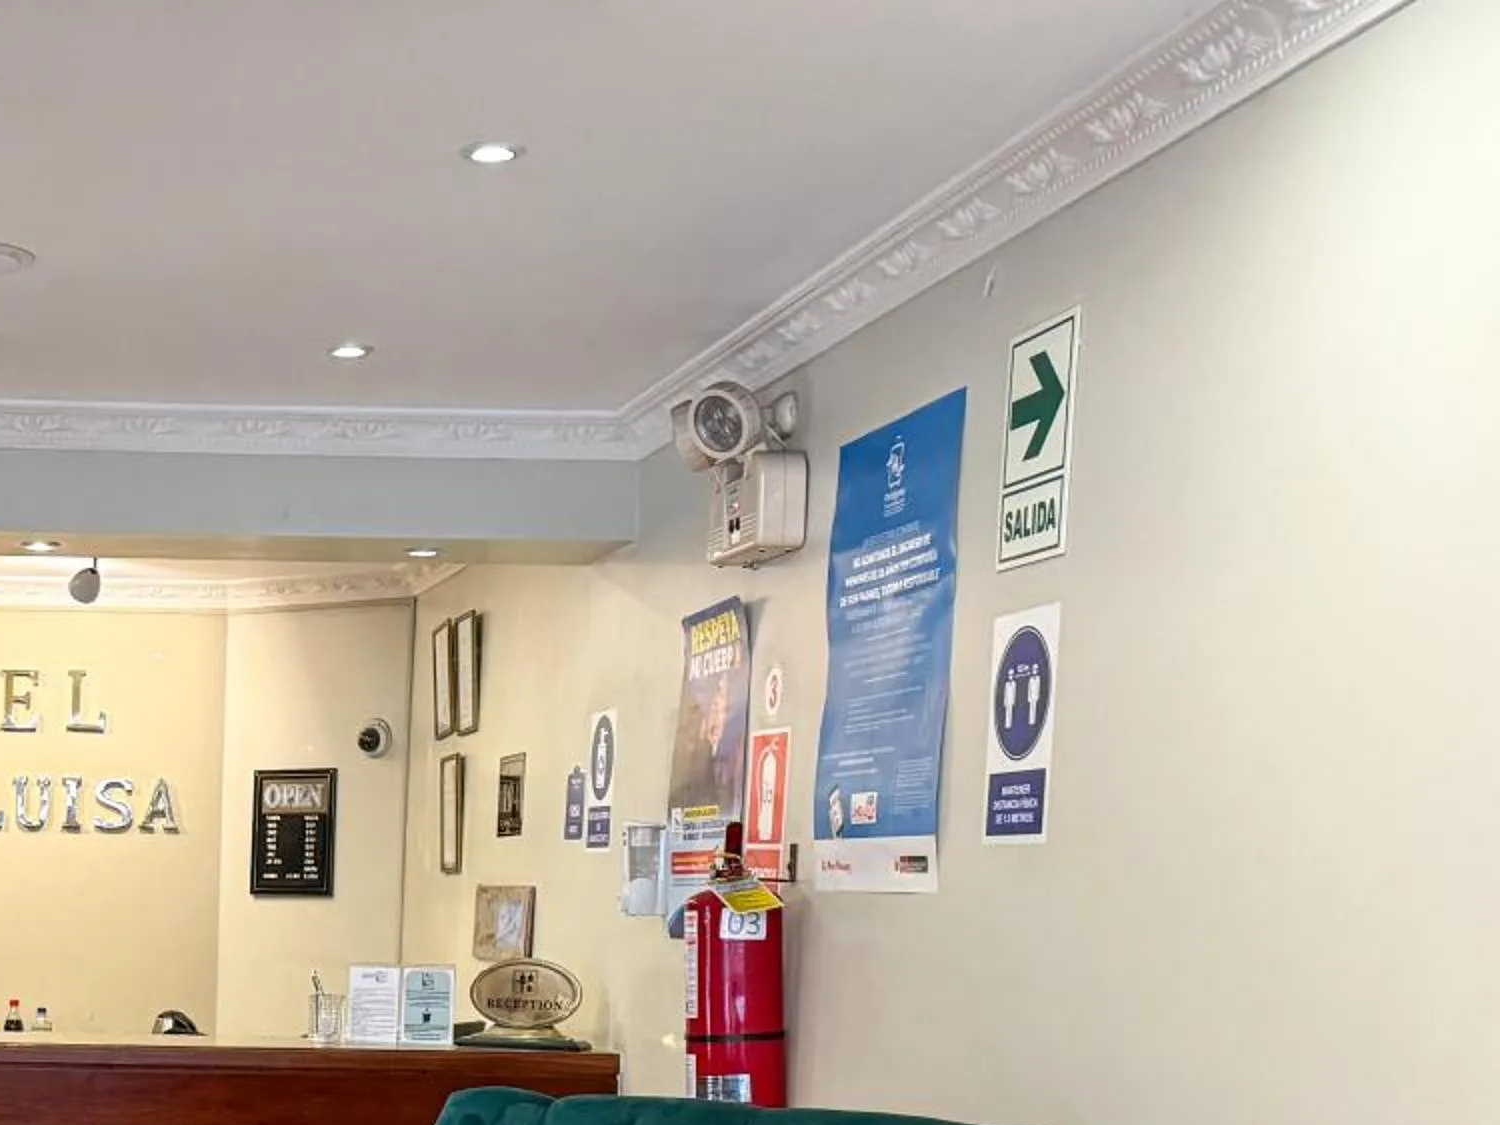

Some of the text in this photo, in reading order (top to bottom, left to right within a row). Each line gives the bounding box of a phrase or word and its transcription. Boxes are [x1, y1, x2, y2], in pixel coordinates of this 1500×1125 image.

[1004, 497, 1056, 543] SALIDA
[768, 674, 777, 708] 3
[264, 783, 325, 808] OPEN
[728, 911, 760, 935] 03
[486, 997, 562, 1011] RECEPTION
